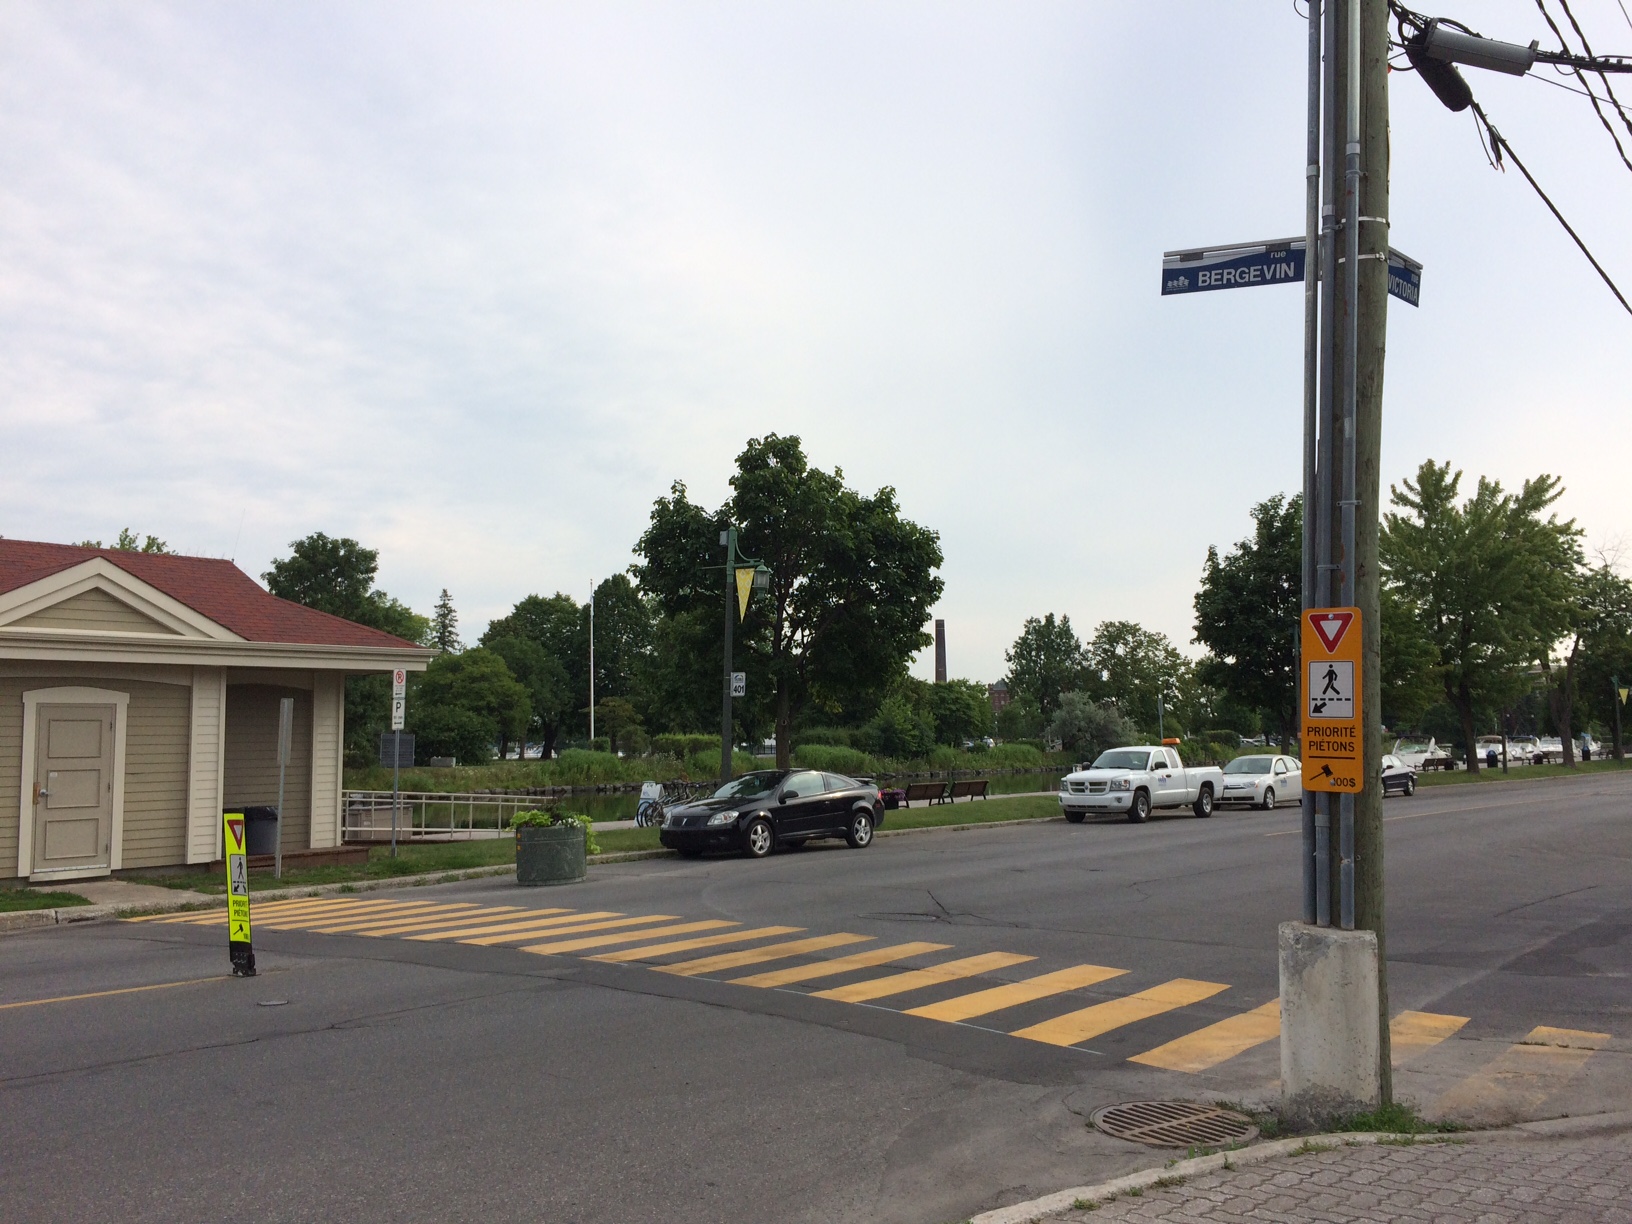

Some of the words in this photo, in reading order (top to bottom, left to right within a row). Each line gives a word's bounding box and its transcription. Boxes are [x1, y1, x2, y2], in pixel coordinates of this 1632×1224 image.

[1198, 262, 1295, 287] BERGEVIN
[1388, 274, 1418, 302] VICTORIA
[733, 685, 745, 694] 401
[1307, 725, 1356, 738] PRIORITÉ
[1308, 739, 1355, 752] PIÉTONS
